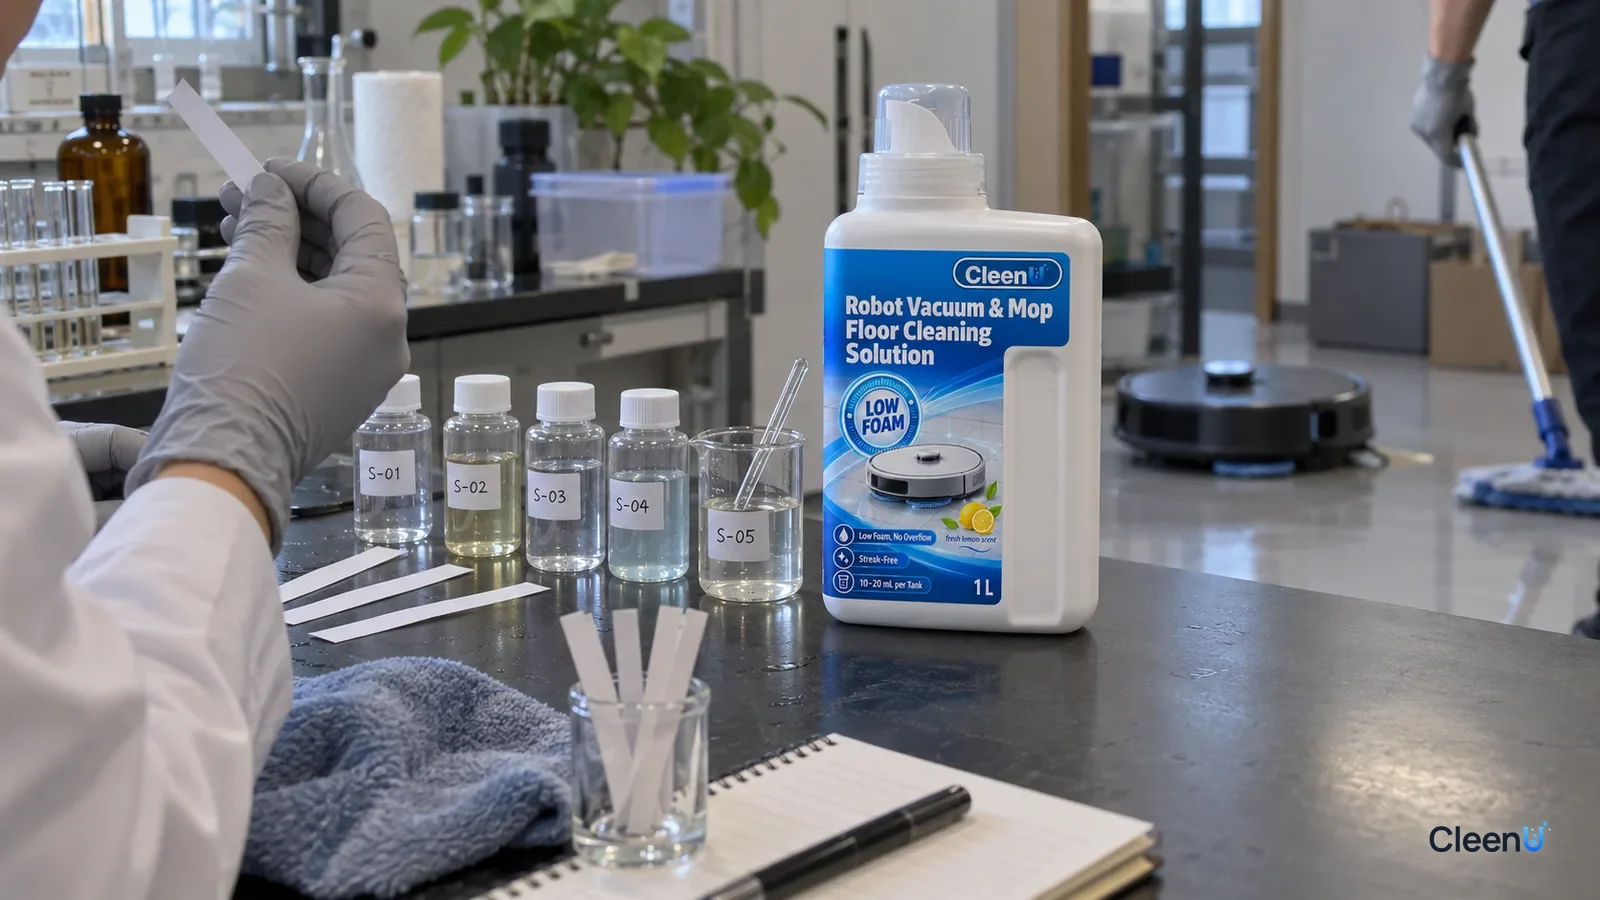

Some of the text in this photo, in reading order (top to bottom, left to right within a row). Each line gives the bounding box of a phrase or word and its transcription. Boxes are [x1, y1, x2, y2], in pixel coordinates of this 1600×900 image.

[965, 265, 1045, 285] CleenU
[845, 295, 1053, 324] Robot Vacuum & Mop
[845, 319, 992, 346] Floor Cleaning
[845, 343, 934, 365] Solution
[865, 397, 900, 417] LOW
[862, 414, 905, 436] FOAM
[368, 465, 400, 481] S-01
[453, 479, 488, 495] S-02
[533, 488, 566, 504] S-03
[615, 496, 650, 514] S-04
[716, 527, 755, 545] S-05
[858, 531, 873, 540] Low
[873, 532, 893, 542] Foam,
[893, 532, 903, 541] No
[945, 534, 961, 542] fresh
[858, 554, 899, 565] Streak-Free
[859, 578, 923, 591] 10-20 mL per Tank
